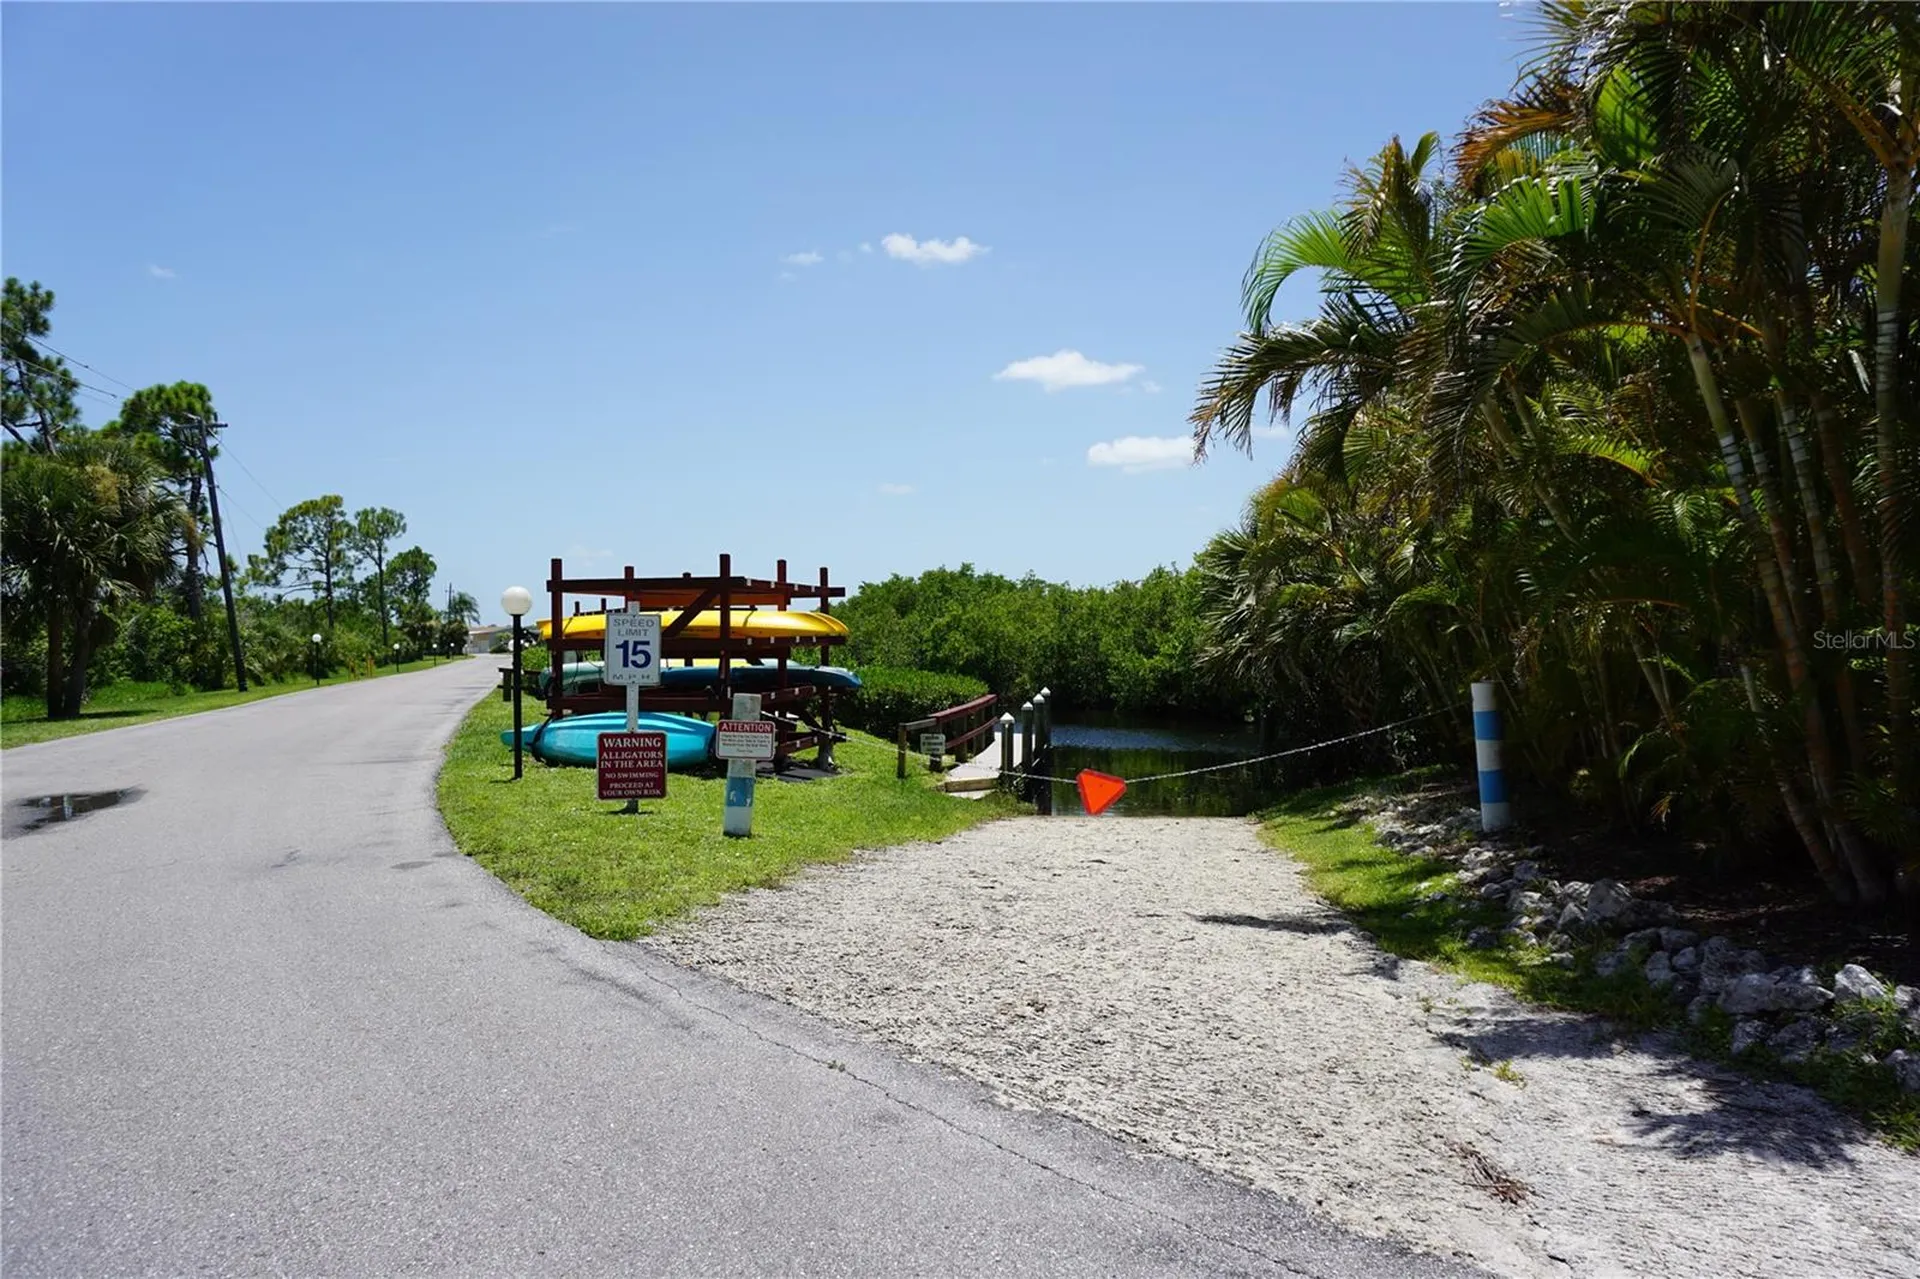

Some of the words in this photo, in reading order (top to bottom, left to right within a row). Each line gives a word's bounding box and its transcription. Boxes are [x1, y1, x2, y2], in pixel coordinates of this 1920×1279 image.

[613, 618, 654, 628] SPEED
[616, 640, 651, 668] 15
[722, 723, 771, 732] ATTENTION
[604, 738, 661, 748] WARNING
